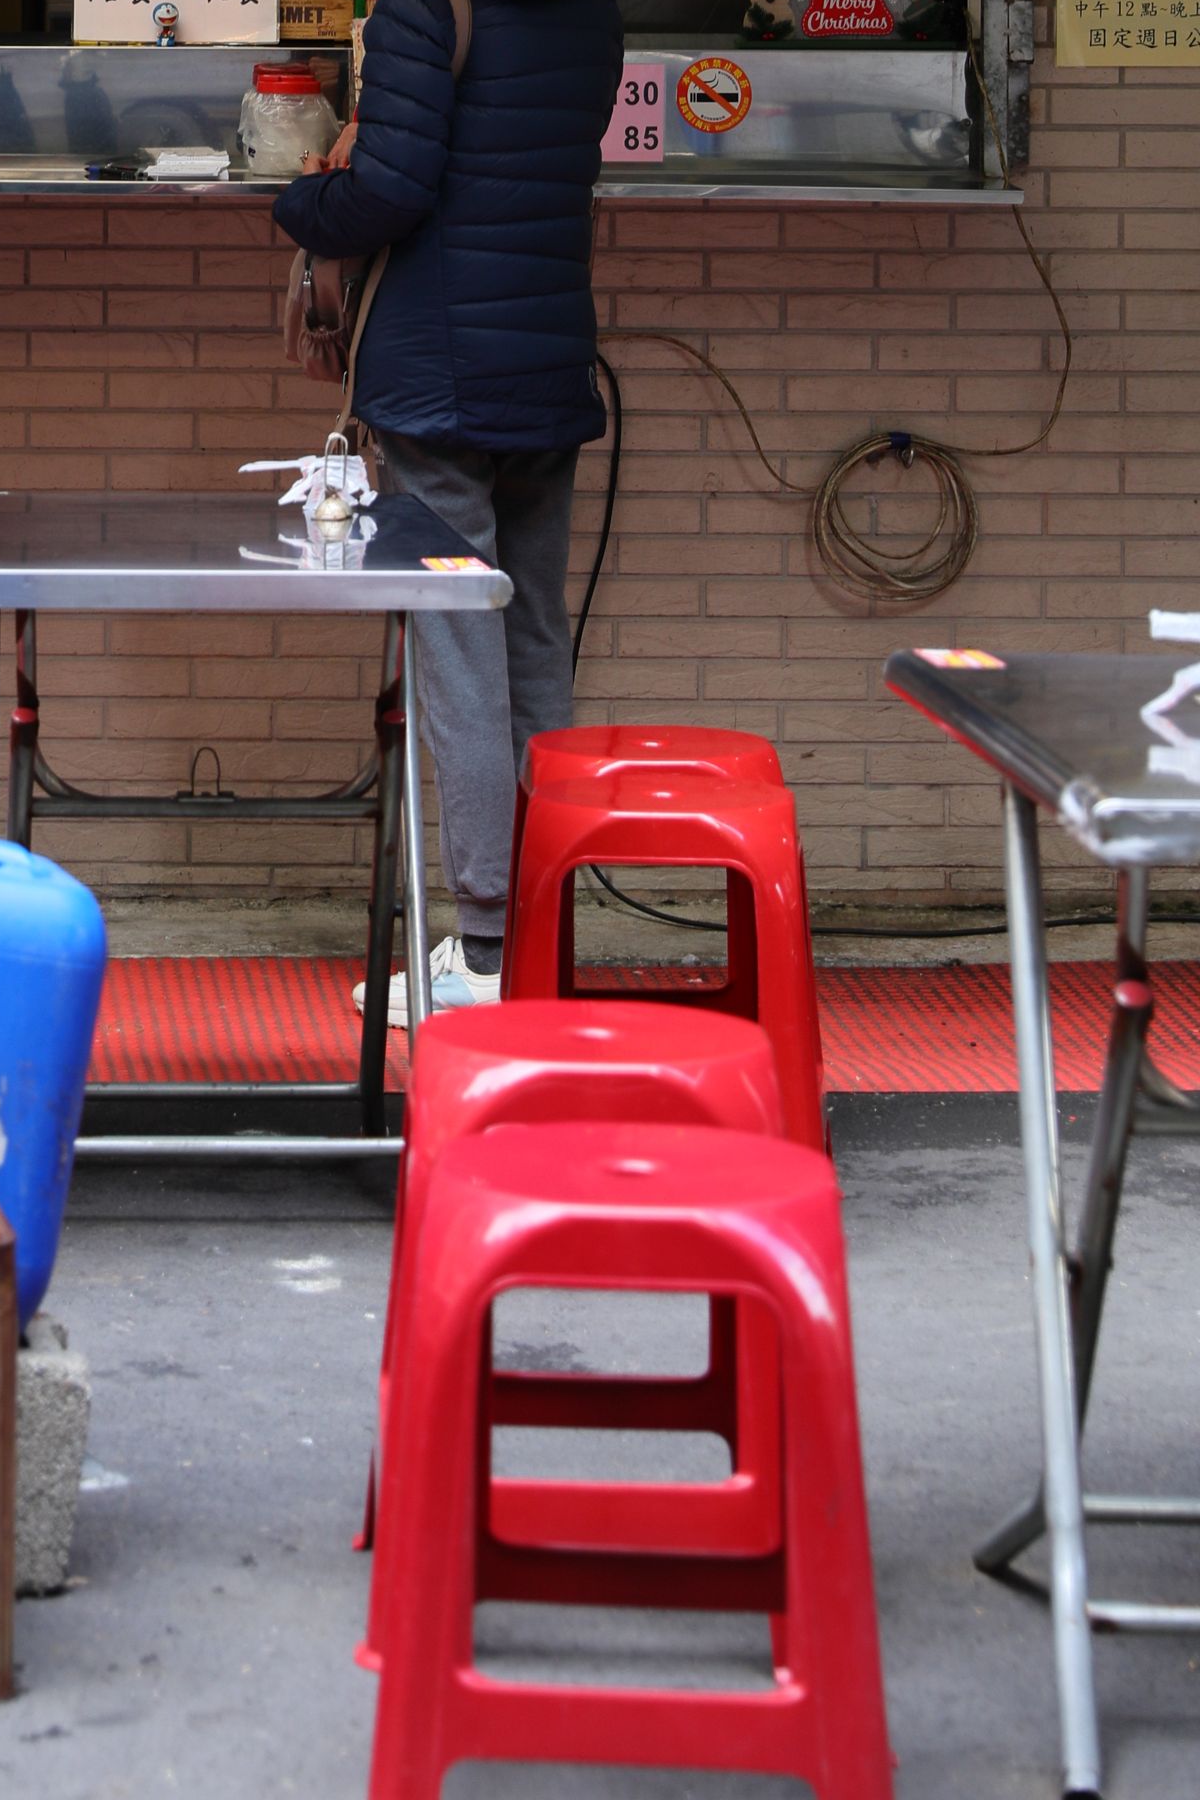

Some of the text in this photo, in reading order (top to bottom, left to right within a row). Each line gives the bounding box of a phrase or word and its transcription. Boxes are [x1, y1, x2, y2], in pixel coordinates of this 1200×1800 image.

[807, 10, 889, 32] Christmas
[1089, 28, 1200, 49] 固定週日公
[624, 126, 659, 150] 85
